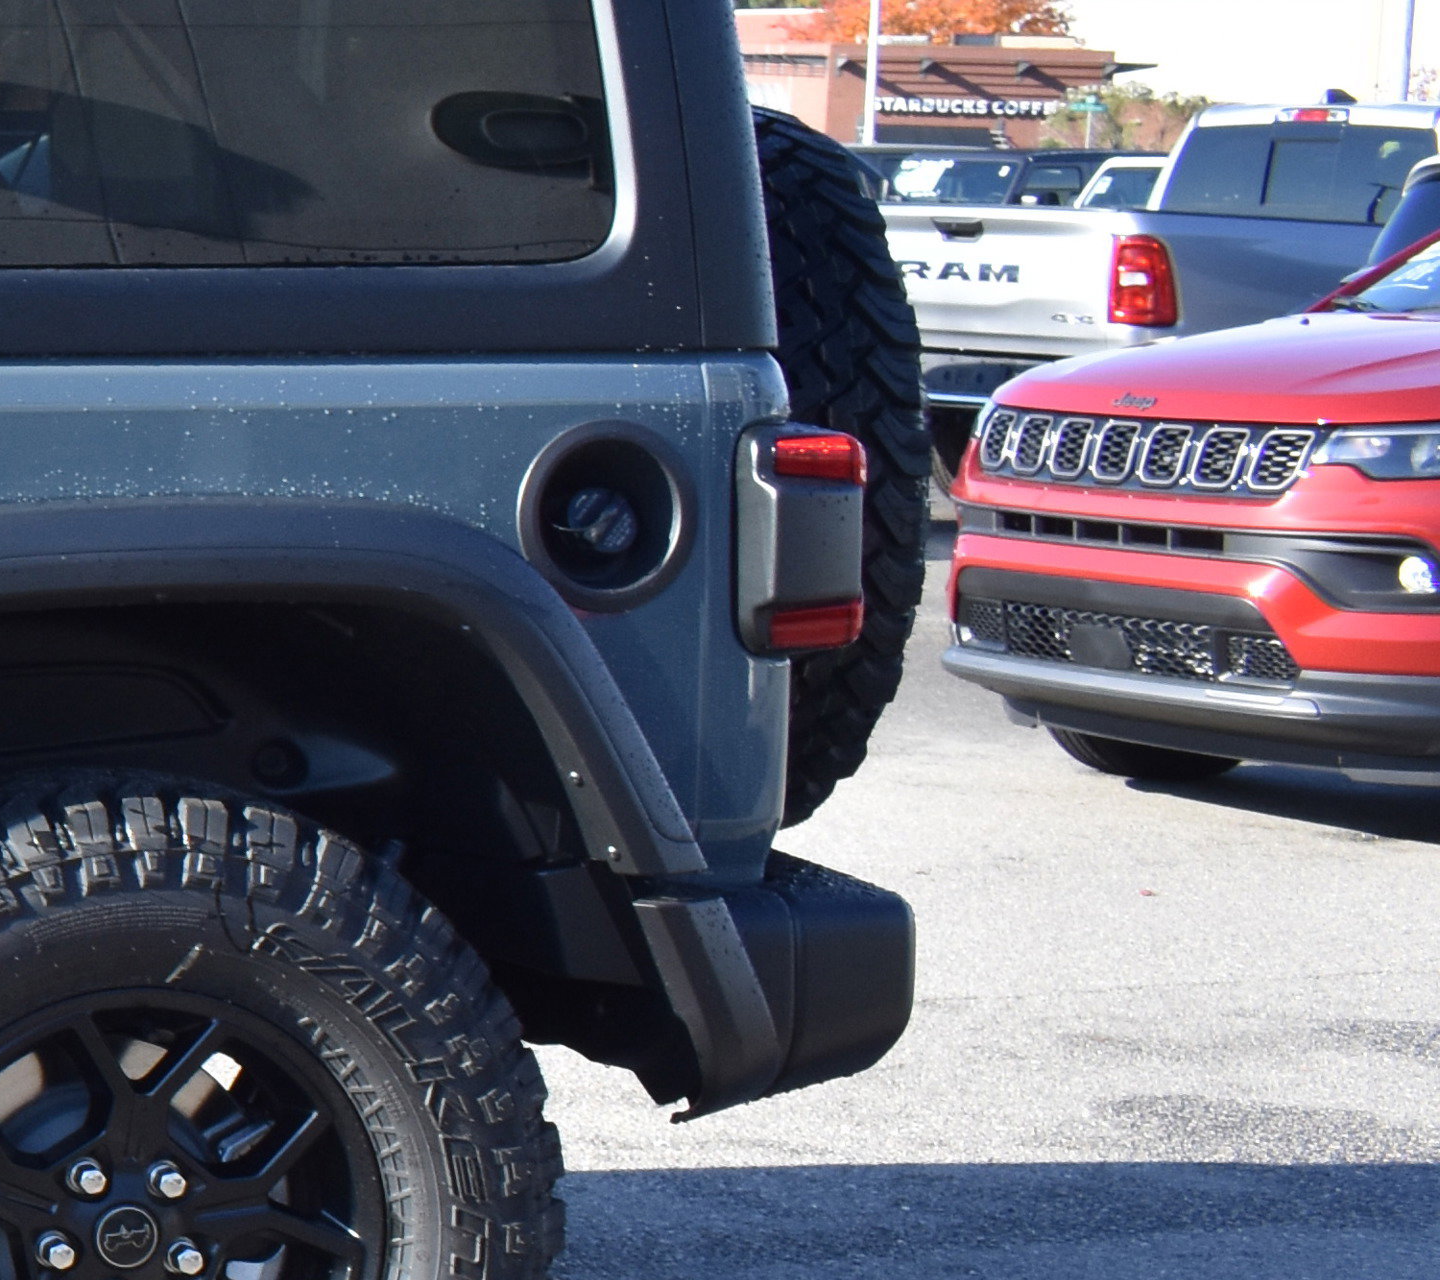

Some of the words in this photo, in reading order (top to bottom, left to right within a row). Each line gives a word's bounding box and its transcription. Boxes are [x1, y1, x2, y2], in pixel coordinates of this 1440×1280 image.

[873, 96, 988, 115] STARBUCKS
[895, 260, 1020, 283] RAM
[1113, 392, 1157, 410] Jeep
